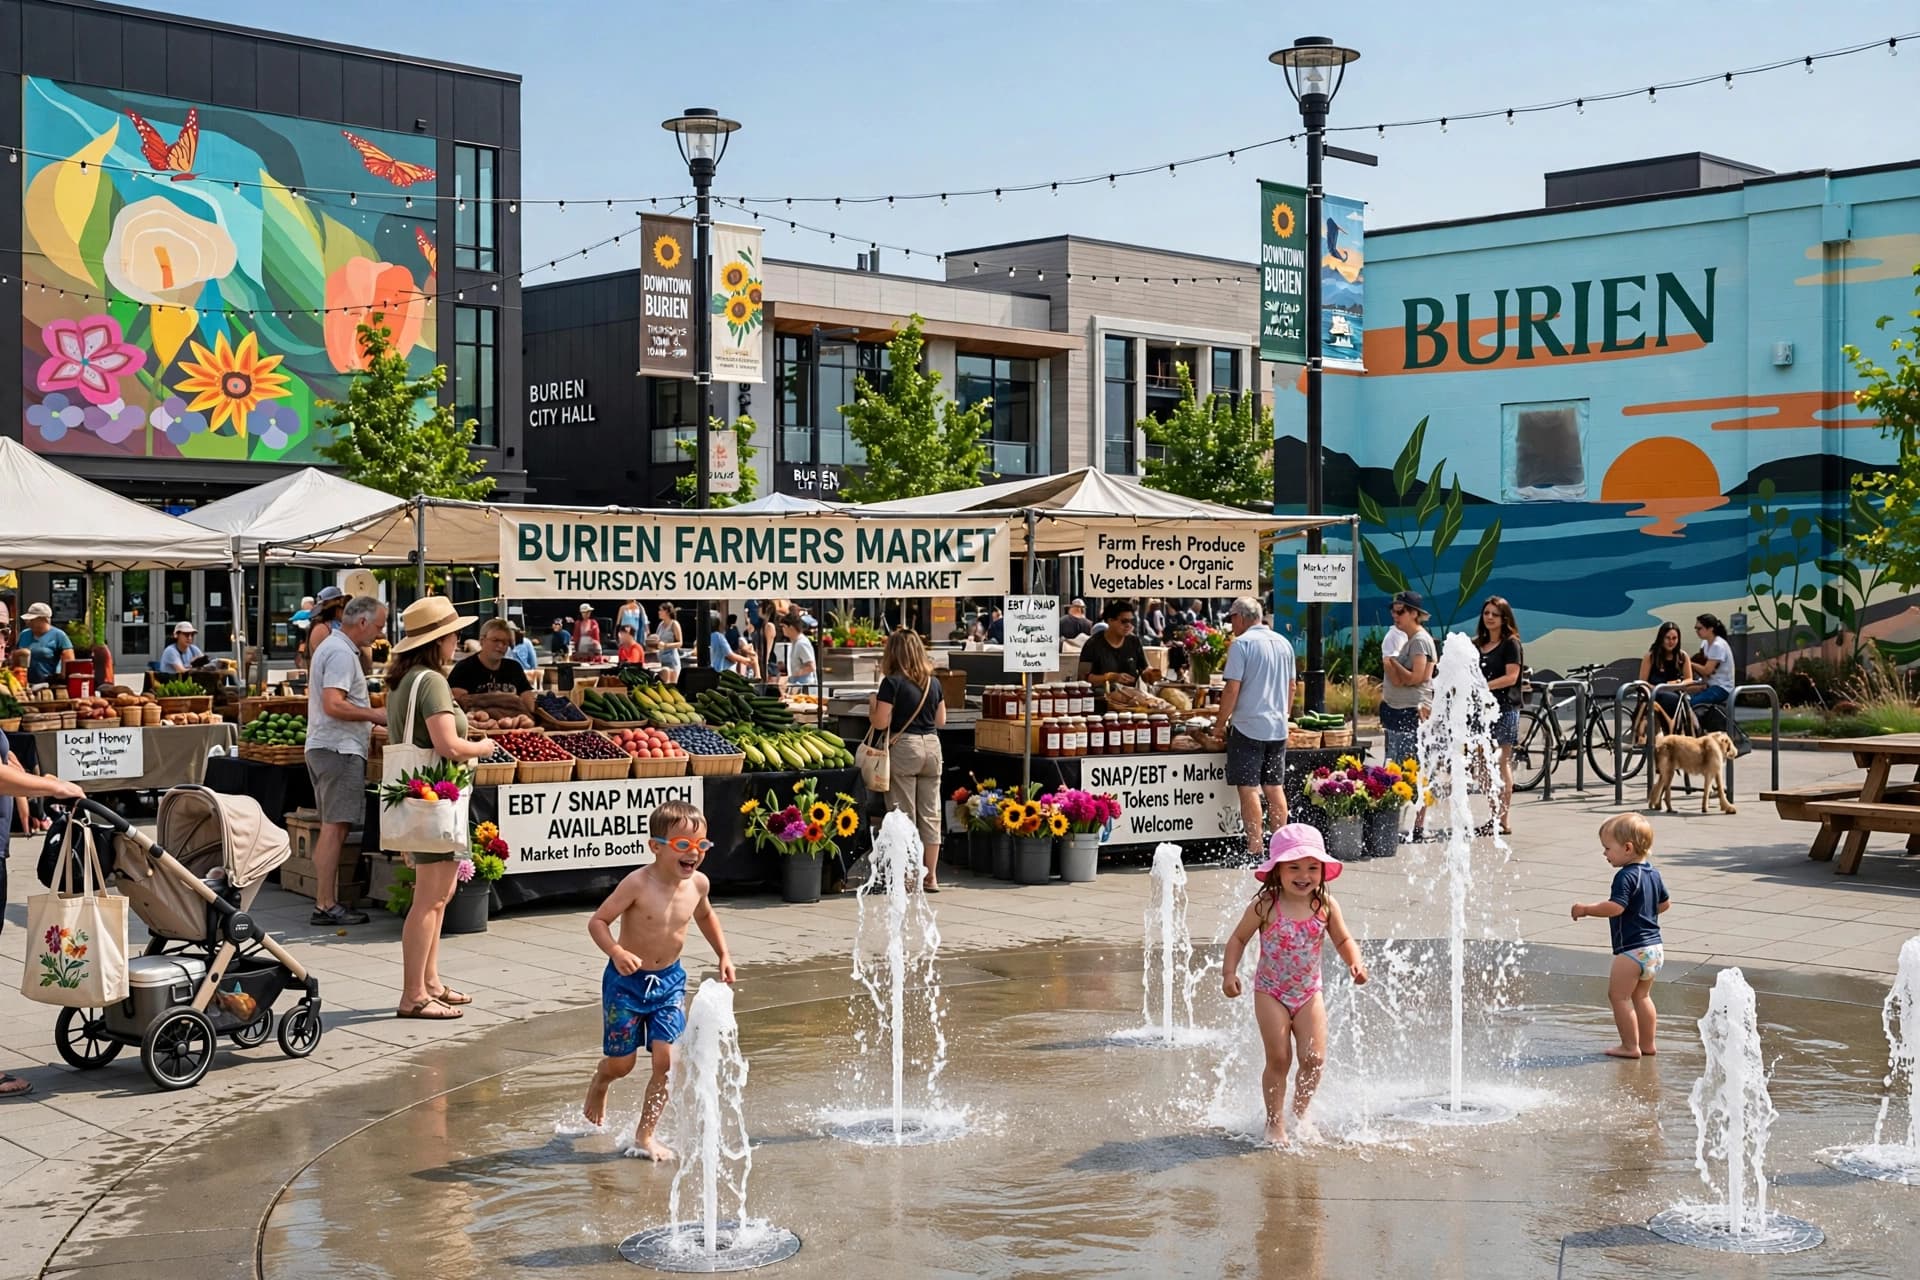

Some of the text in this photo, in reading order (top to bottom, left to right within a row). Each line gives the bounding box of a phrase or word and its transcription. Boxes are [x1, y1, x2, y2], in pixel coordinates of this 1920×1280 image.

[1263, 244, 1304, 268] DOWNTOWN
[643, 274, 692, 295] DOWNTOWN
[1264, 267, 1302, 295] BURIEN
[645, 295, 688, 319] BURIEN
[1402, 267, 1717, 369] BURIEN
[530, 379, 584, 403] BURIEN
[529, 404, 596, 427] CITY HALL
[793, 469, 838, 482] BUREN
[518, 523, 996, 564] BURIEN FARMERS MARKET
[1099, 534, 1245, 552] Farm Fresh Produce
[1106, 553, 1234, 574] Produce Organic
[553, 570, 962, 591] THURSDAYS 10AM-6PM SUMMER MARKET
[1090, 573, 1252, 593] Vegetables Local Farms
[65, 731, 132, 745] Local Honey
[1091, 762, 1228, 787] SNAP/EBT Marke
[509, 793, 546, 815] EBT
[568, 789, 621, 812] SNAP
[627, 786, 692, 809] MATCH
[1122, 788, 1204, 808] Tokens Here
[548, 814, 648, 839] AVAILABLE
[1131, 815, 1193, 834] Welcome
[521, 839, 644, 862] Market Info Booth
